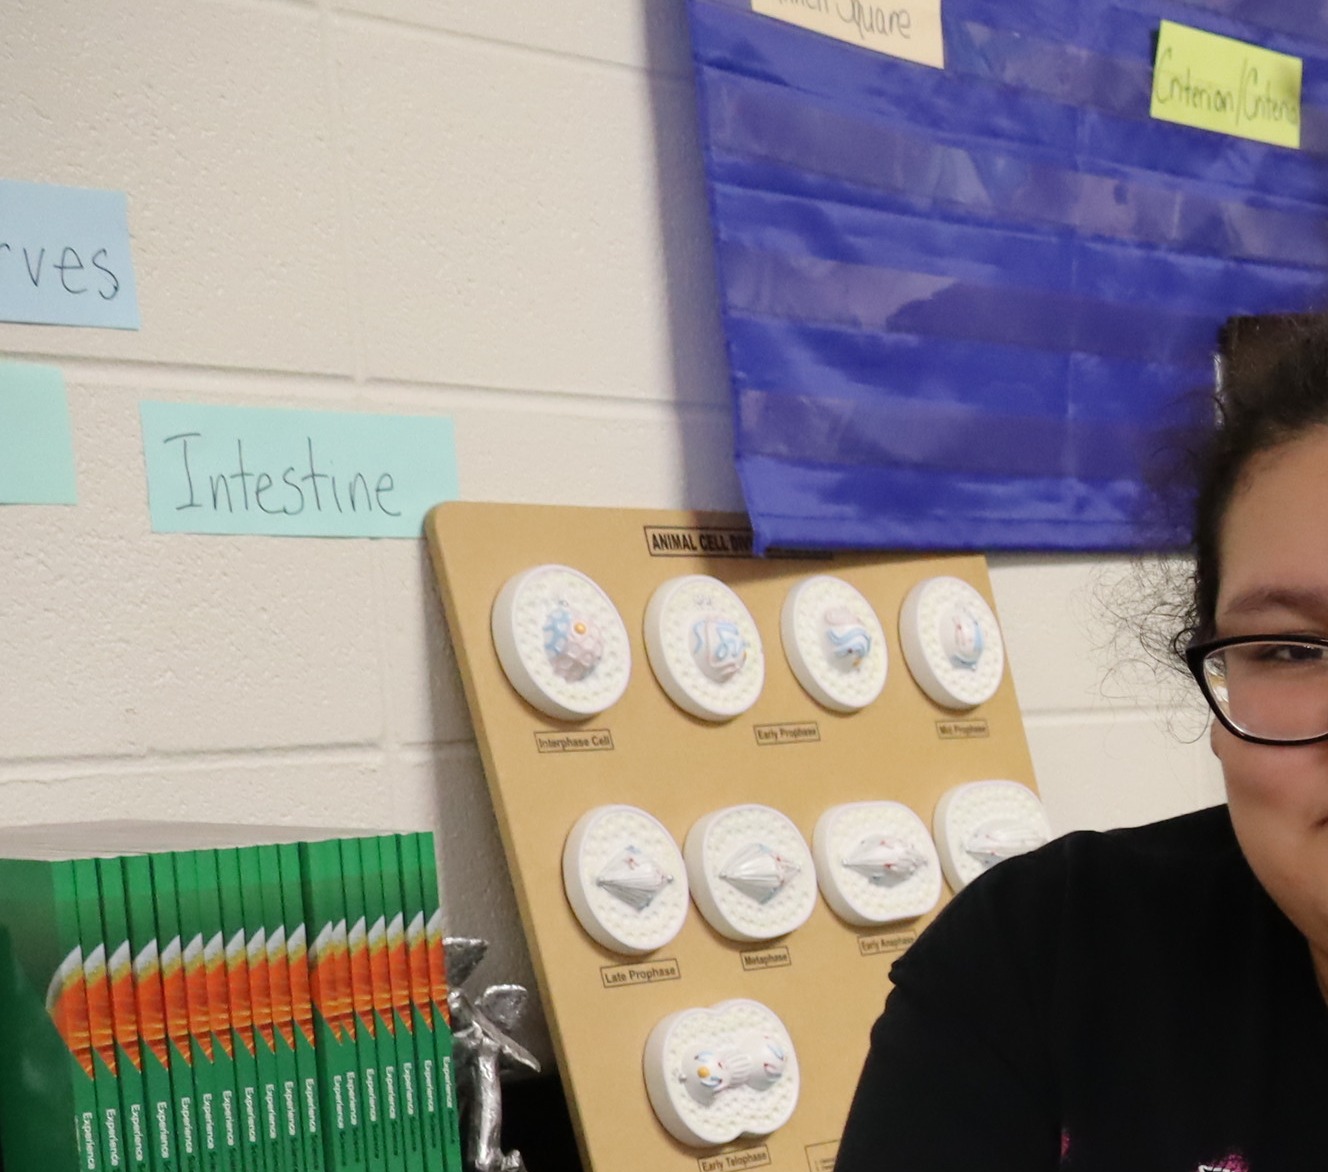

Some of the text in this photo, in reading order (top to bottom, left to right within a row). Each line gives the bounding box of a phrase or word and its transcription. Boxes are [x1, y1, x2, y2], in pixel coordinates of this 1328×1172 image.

[163, 431, 402, 517] Intestine
[651, 533, 697, 550] ANIMAL
[700, 534, 729, 551] CELL
[538, 735, 610, 751] Interphase Cell
[604, 966, 676, 984] Late Prophase
[744, 953, 788, 967] Metaphase
[181, 1097, 193, 1153] Experience
[202, 1093, 214, 1149] Experience
[222, 1090, 234, 1146] Experience
[244, 1087, 256, 1142] Experience
[265, 1084, 276, 1139] Experience
[284, 1081, 295, 1135] Experience
[305, 1078, 316, 1132] Experience
[333, 1075, 344, 1128] Experience
[82, 1112, 95, 1170] Experience
[105, 1109, 119, 1166] Experience
[131, 1104, 143, 1161] Experience
[156, 1101, 169, 1158] Experience
[702, 1159, 724, 1172] Early
